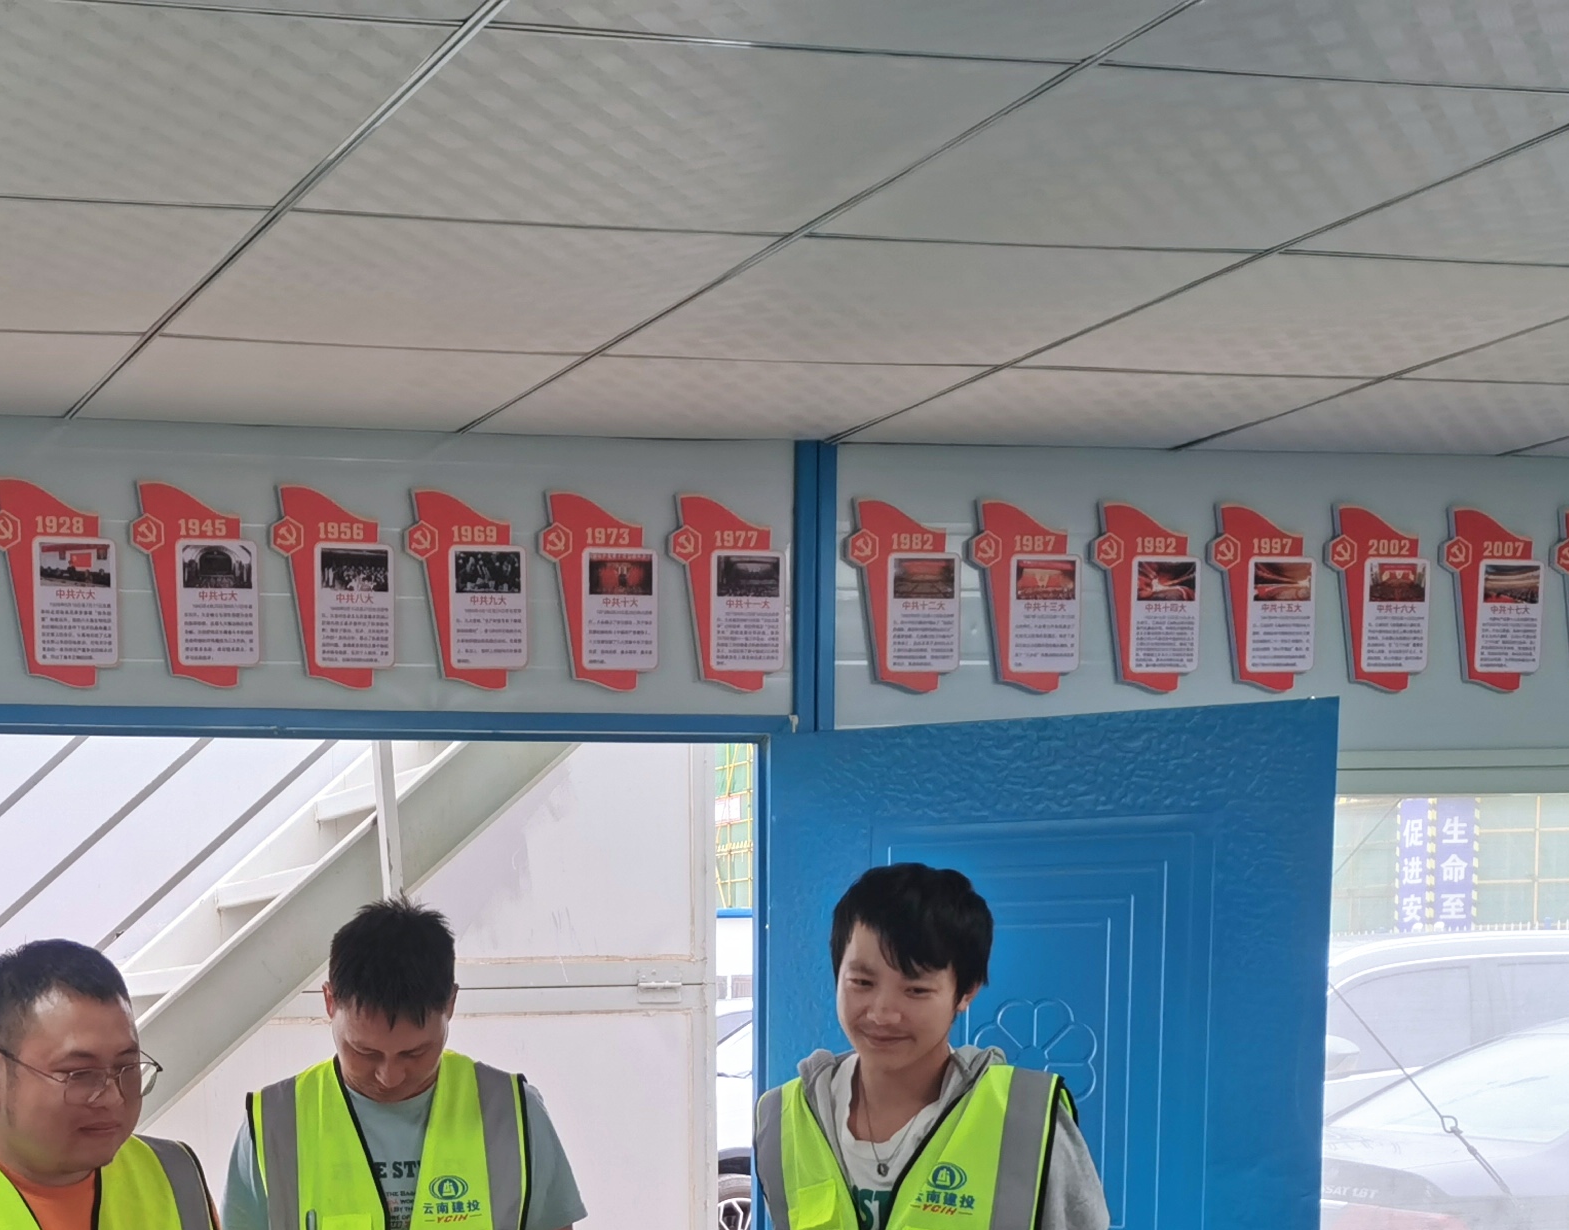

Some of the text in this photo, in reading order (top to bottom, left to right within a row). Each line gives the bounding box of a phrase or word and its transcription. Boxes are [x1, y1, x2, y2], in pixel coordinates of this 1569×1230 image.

[35, 516, 85, 534] 1928
[178, 519, 227, 537] 1945
[318, 522, 364, 540] 1956
[451, 525, 497, 542] 1969
[585, 527, 630, 545] 1973
[713, 531, 758, 547] 1977
[891, 533, 933, 550] 1982
[1014, 535, 1056, 551] 1987
[1135, 537, 1177, 553] 1992
[1252, 538, 1292, 554] 1997
[1368, 539, 1410, 555] 2002
[1483, 541, 1524, 557] 2007
[55, 588, 96, 600] 中共六大
[198, 590, 238, 602] 中共七大
[336, 593, 375, 605] 中共八大
[470, 595, 507, 606] 中共九大
[602, 597, 639, 608] 中共十大
[725, 598, 771, 609] 中共十一大
[901, 601, 945, 611] 中共十二大
[1024, 602, 1067, 612] 中共十三大
[1145, 603, 1187, 613] 中共十四大
[1261, 603, 1302, 613] 中共十五大
[1376, 604, 1417, 614] 中共十六大
[1490, 605, 1530, 615] 中共十七大
[1401, 818, 1424, 923] 促进安
[1439, 816, 1469, 920] 生命至
[392, 1160, 421, 1179] ST
[1323, 1185, 1350, 1196] SAT
[423, 1200, 481, 1214] 云南建投
[922, 1203, 957, 1216] YCIH
[437, 1213, 469, 1223] YCIH
